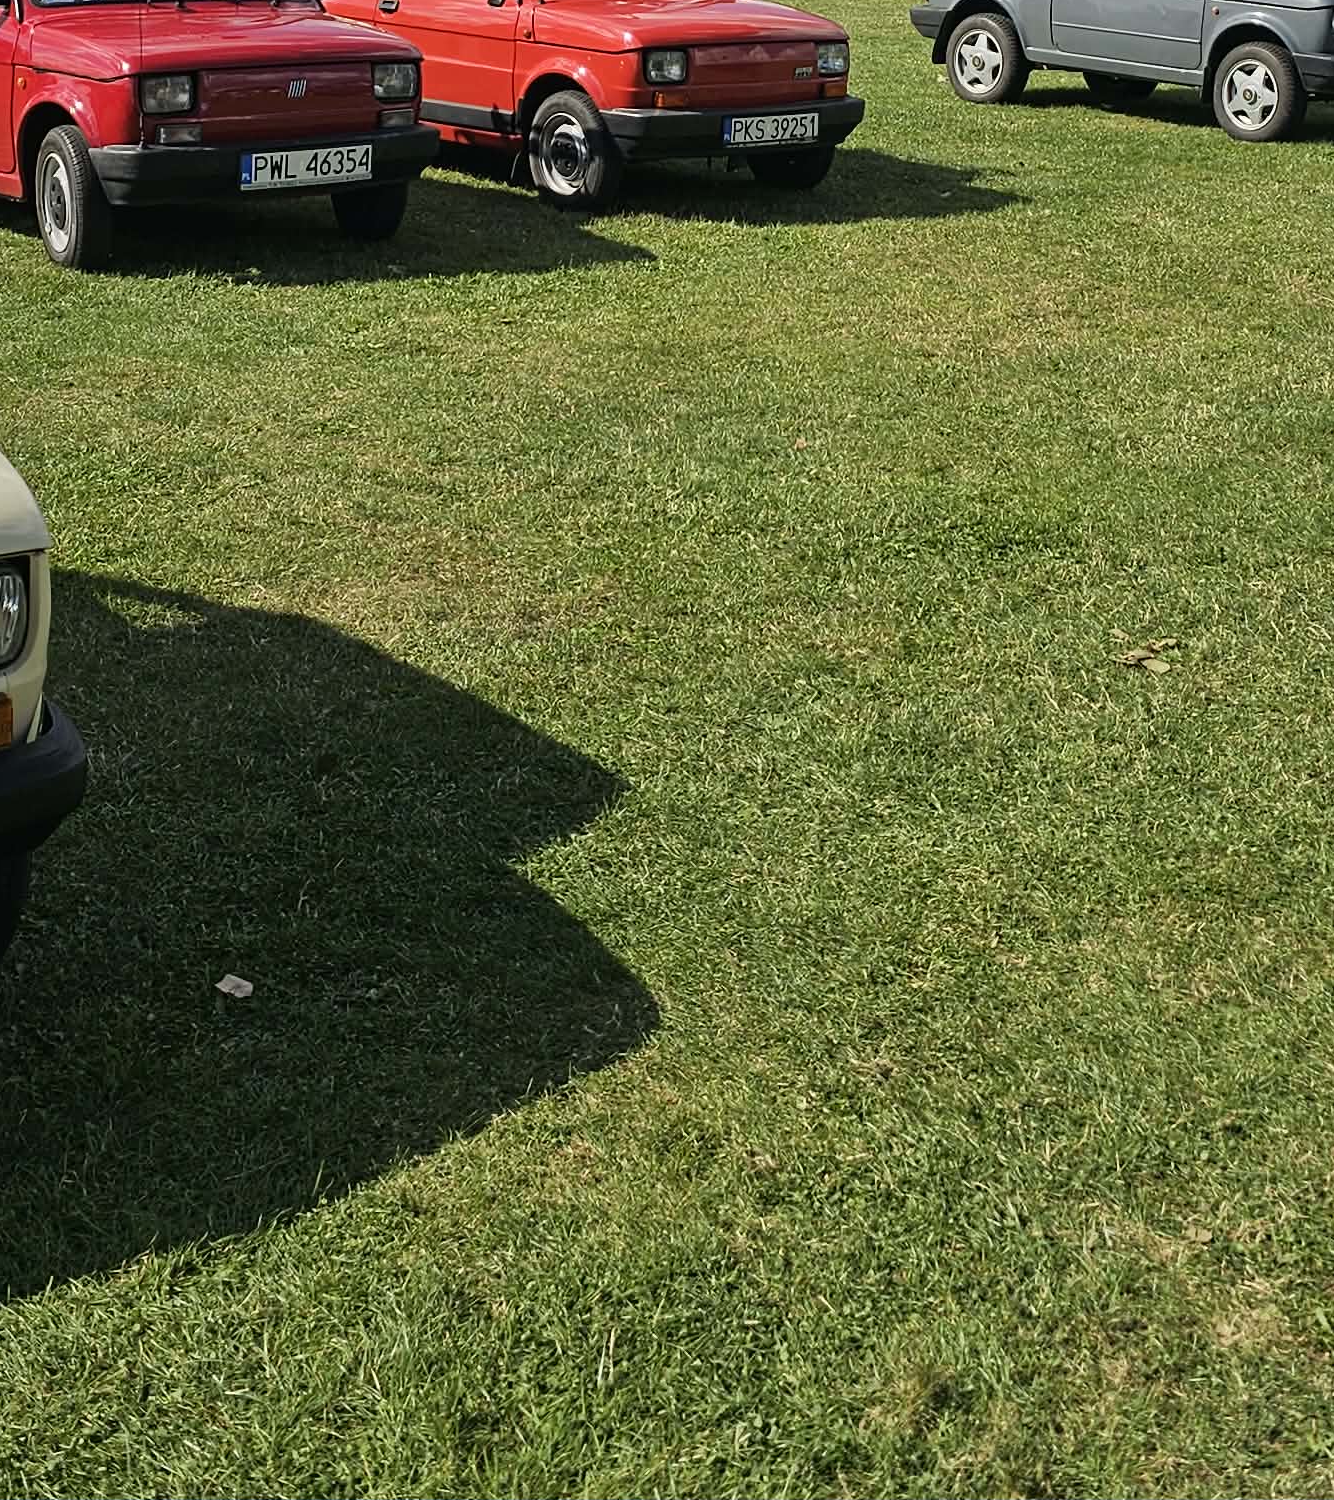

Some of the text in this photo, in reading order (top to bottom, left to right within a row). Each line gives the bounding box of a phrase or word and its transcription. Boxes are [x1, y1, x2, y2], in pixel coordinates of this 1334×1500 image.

[732, 115, 816, 142] PKS 39251
[253, 154, 297, 182] PWL
[305, 147, 370, 177] 46354
